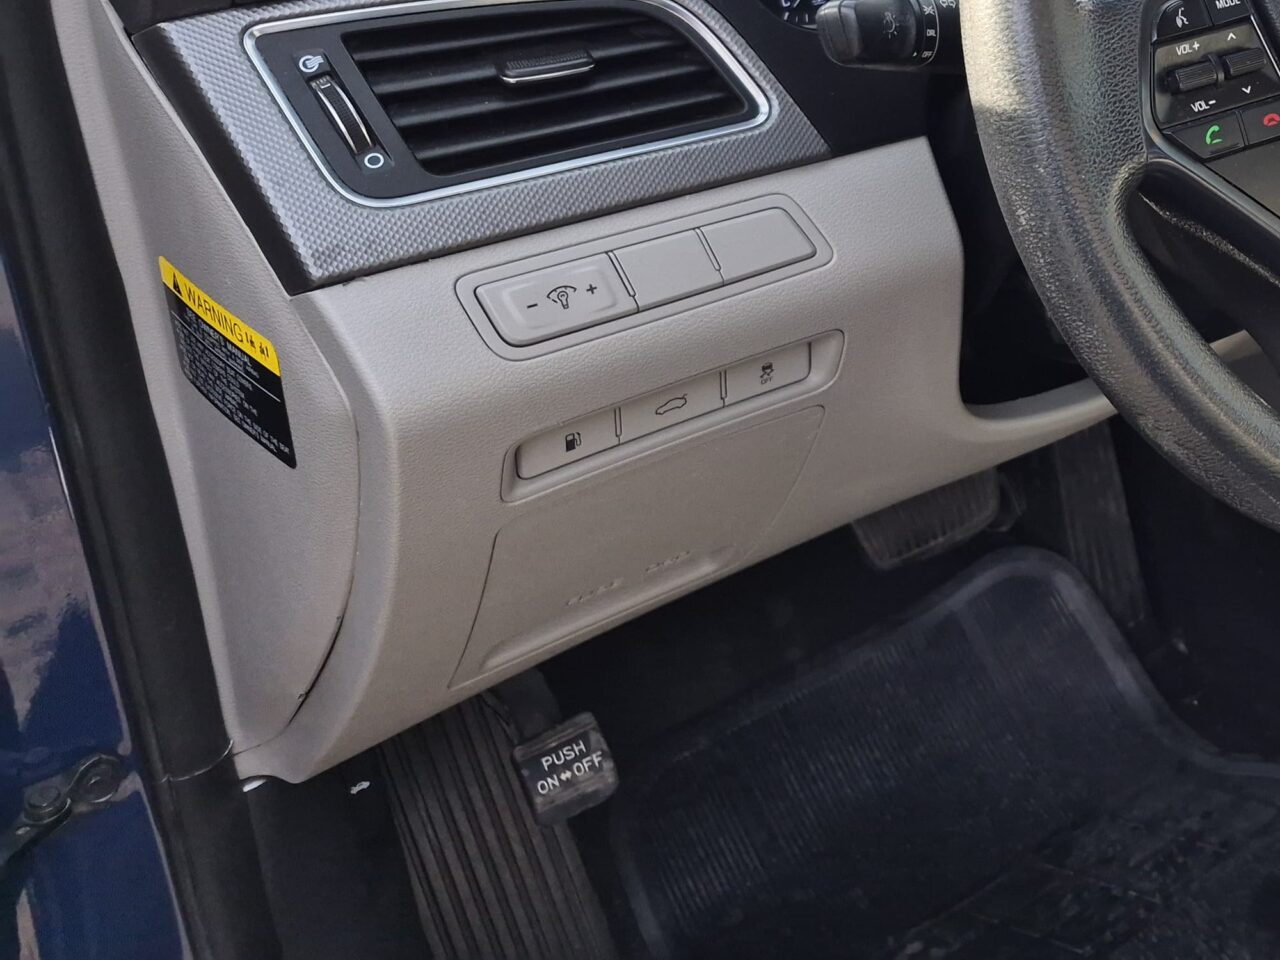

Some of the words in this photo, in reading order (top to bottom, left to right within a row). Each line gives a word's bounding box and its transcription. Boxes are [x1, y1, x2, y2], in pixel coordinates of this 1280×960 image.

[184, 284, 244, 343] WARNING
[537, 774, 561, 794] ON
[572, 751, 603, 776] OFF
[541, 739, 587, 772] PUSH
